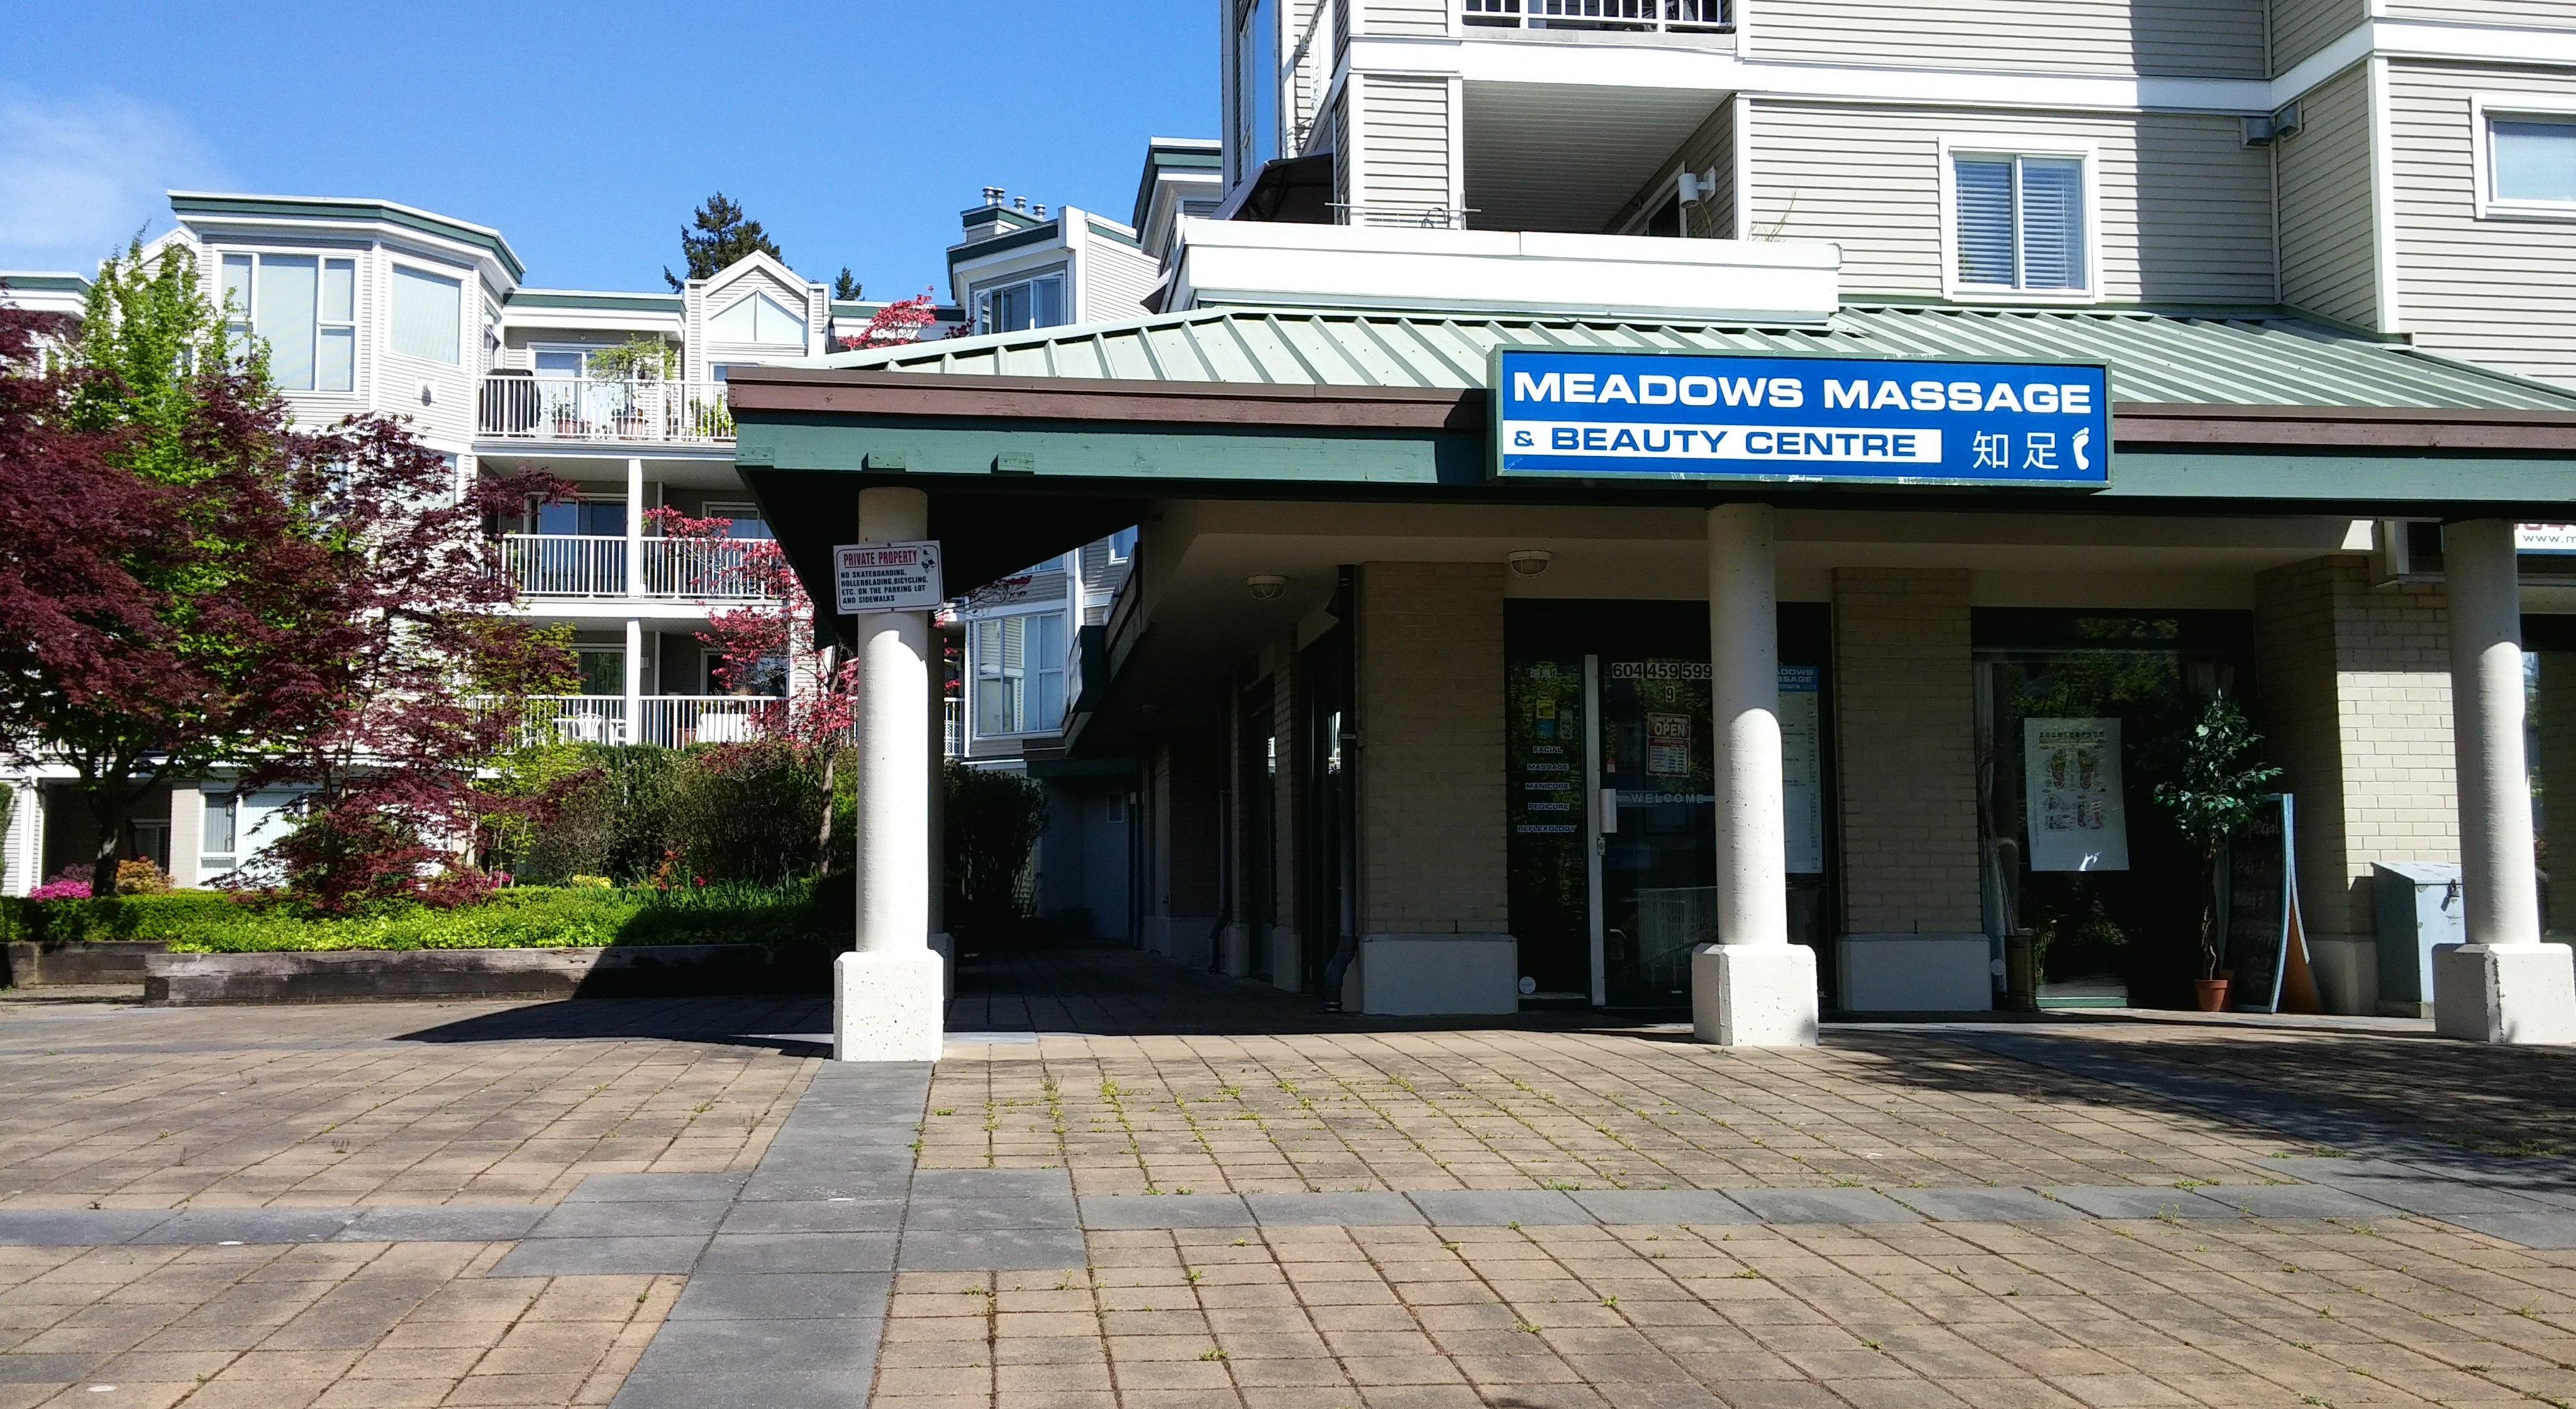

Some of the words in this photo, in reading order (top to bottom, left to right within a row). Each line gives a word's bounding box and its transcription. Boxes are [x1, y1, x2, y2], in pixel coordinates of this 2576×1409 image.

[1513, 372, 1804, 409] MEADOWS
[1823, 379, 2092, 414] MASSAGE
[1514, 430, 1535, 447] &
[1552, 426, 1729, 453] BEAUTY
[1745, 431, 1916, 457] CENTRE
[1972, 430, 2061, 470] 知足
[843, 552, 875, 565] PRIVATE
[879, 550, 917, 564] PROPERTY
[853, 569, 906, 577] SKATEBOARDING,
[858, 595, 895, 603] SIDEWALKS
[1613, 664, 1643, 677] 604
[1648, 664, 1679, 678] 459
[1667, 687, 1674, 701] 9
[1654, 722, 1685, 737] OPEN
[1631, 793, 1704, 804] WELCOME
